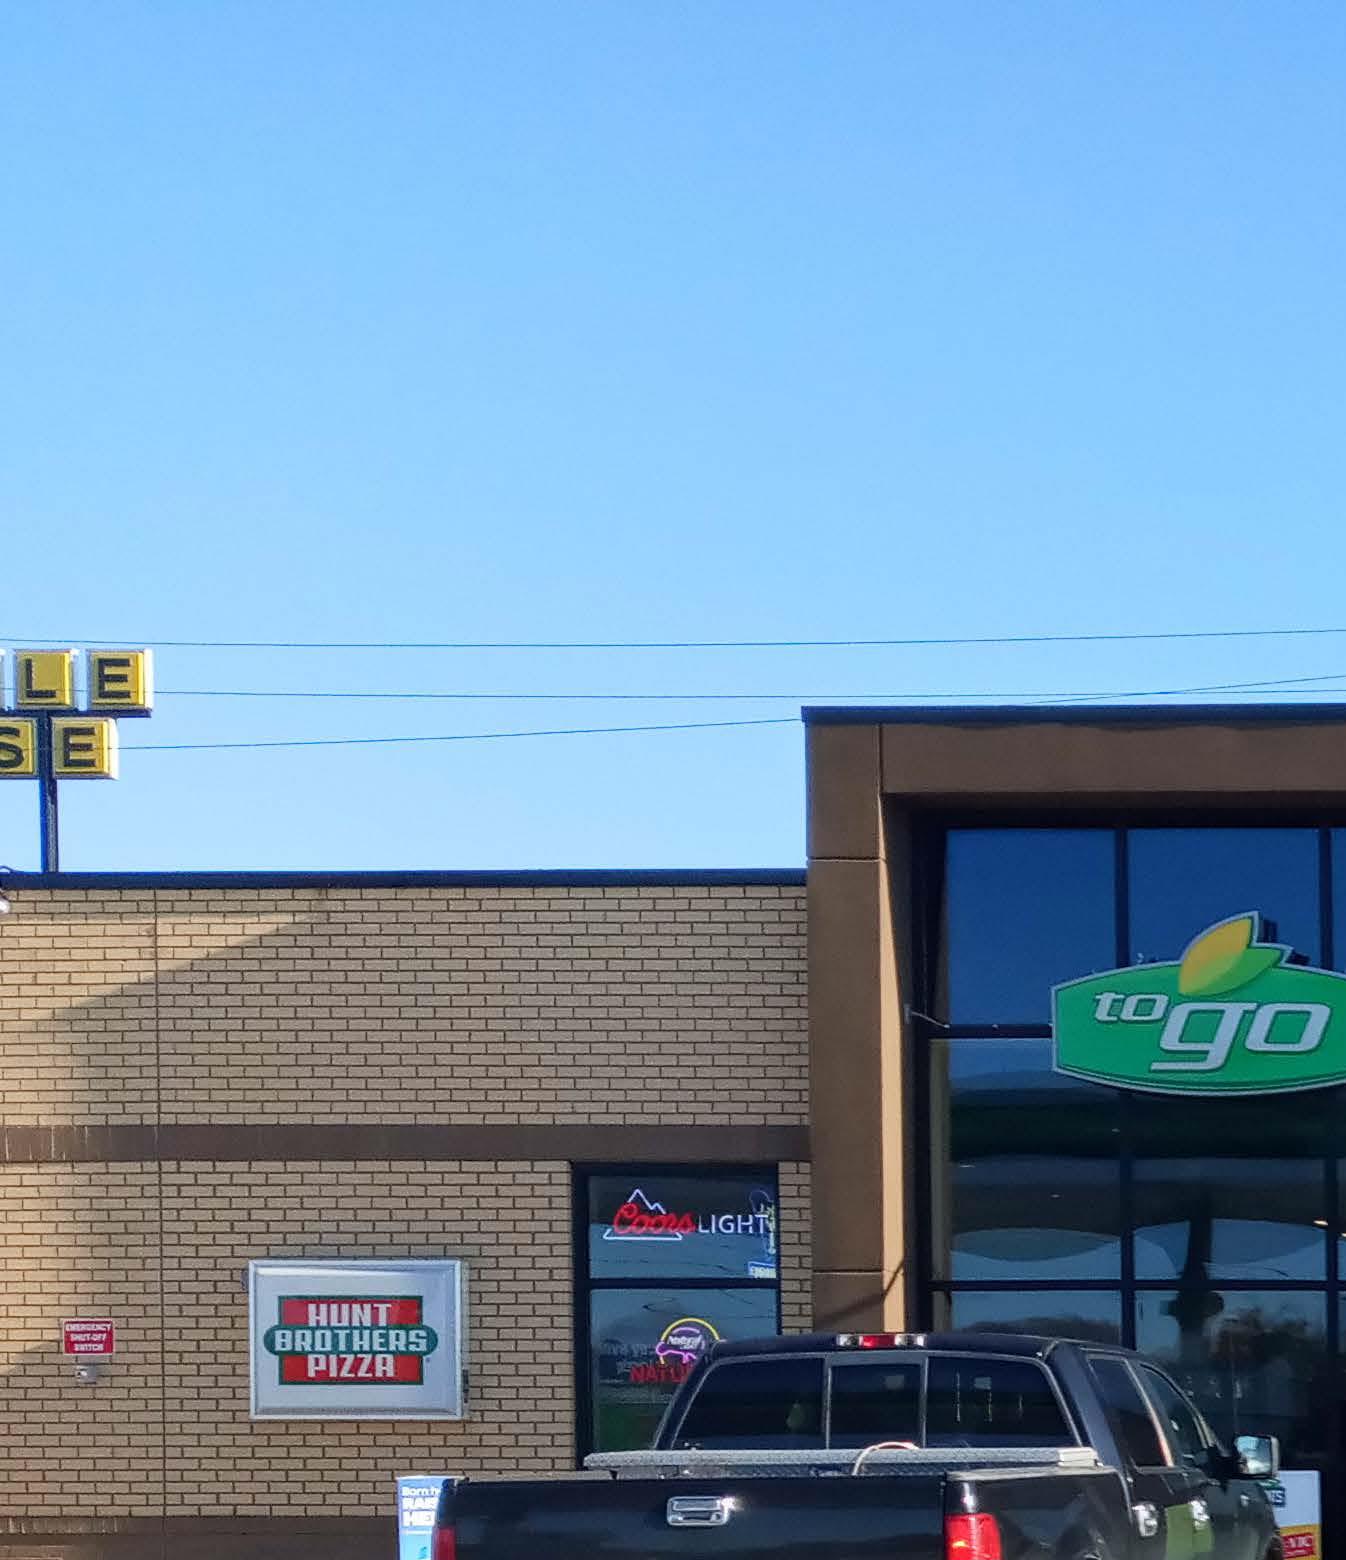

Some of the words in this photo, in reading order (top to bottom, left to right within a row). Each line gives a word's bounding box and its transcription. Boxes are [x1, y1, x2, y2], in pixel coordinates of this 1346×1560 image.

[1094, 992, 1169, 1022] to
[1150, 1002, 1331, 1071] go
[613, 1202, 696, 1234] Coors
[698, 1213, 769, 1233] LIGHT
[307, 1303, 392, 1327] HUNT
[274, 1329, 427, 1351] BROTHERS
[307, 1354, 395, 1378] PIZZA
